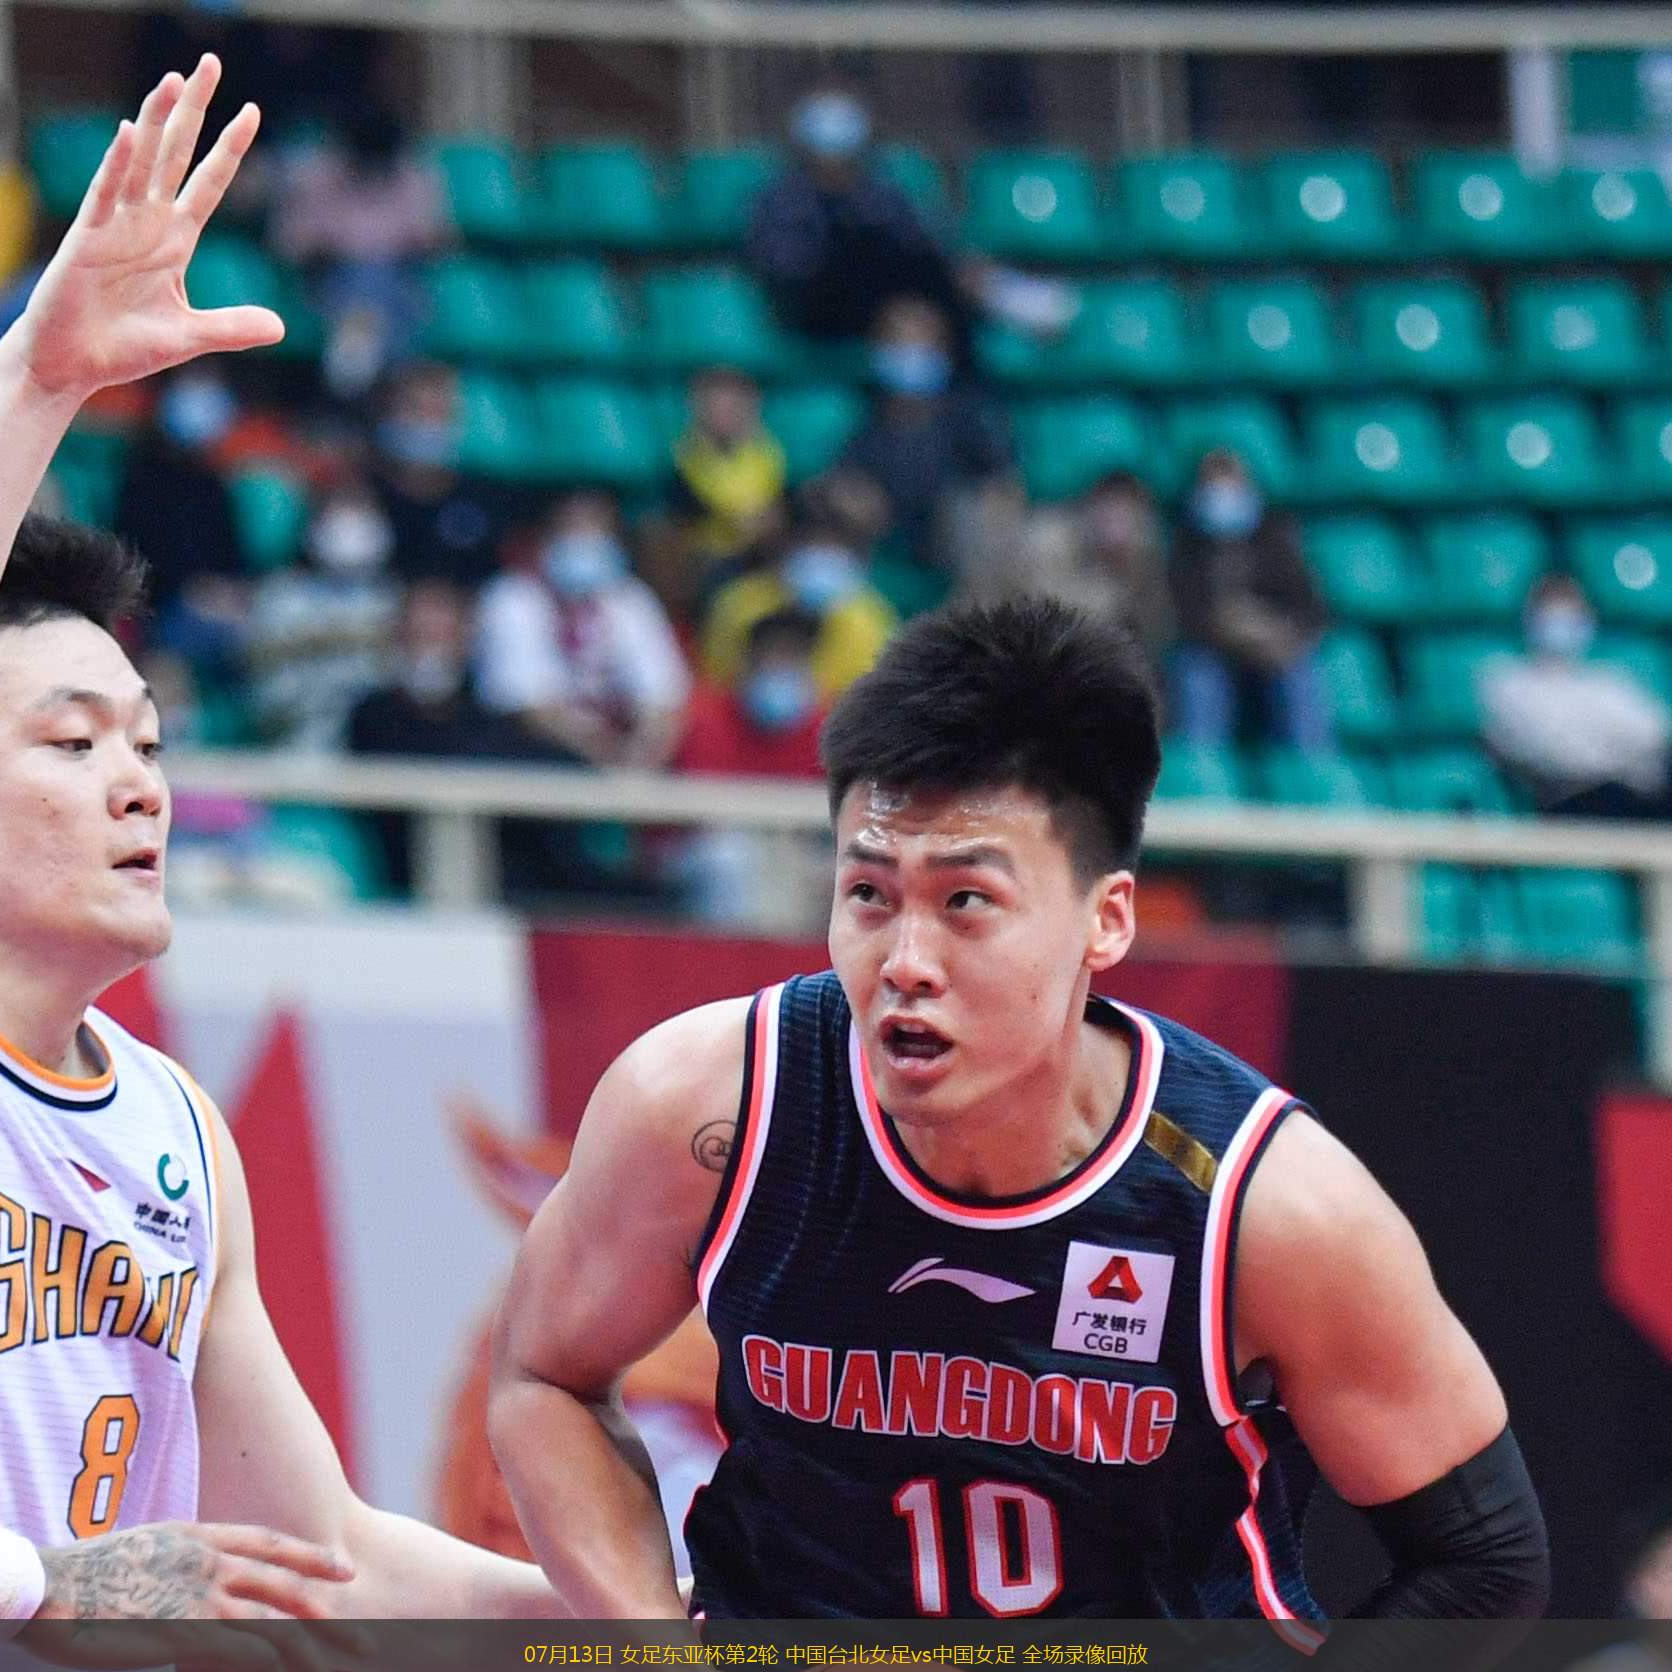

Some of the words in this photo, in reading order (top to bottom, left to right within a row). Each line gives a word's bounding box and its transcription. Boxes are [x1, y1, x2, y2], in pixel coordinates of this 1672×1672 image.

[135, 1201, 191, 1231] 中国人
[1072, 1311, 1147, 1336] 广发银行
[1084, 1332, 1129, 1354] CGB
[742, 1335, 1177, 1465] GUANGDONG
[67, 1393, 141, 1541] 8
[893, 1479, 1065, 1619] 10
